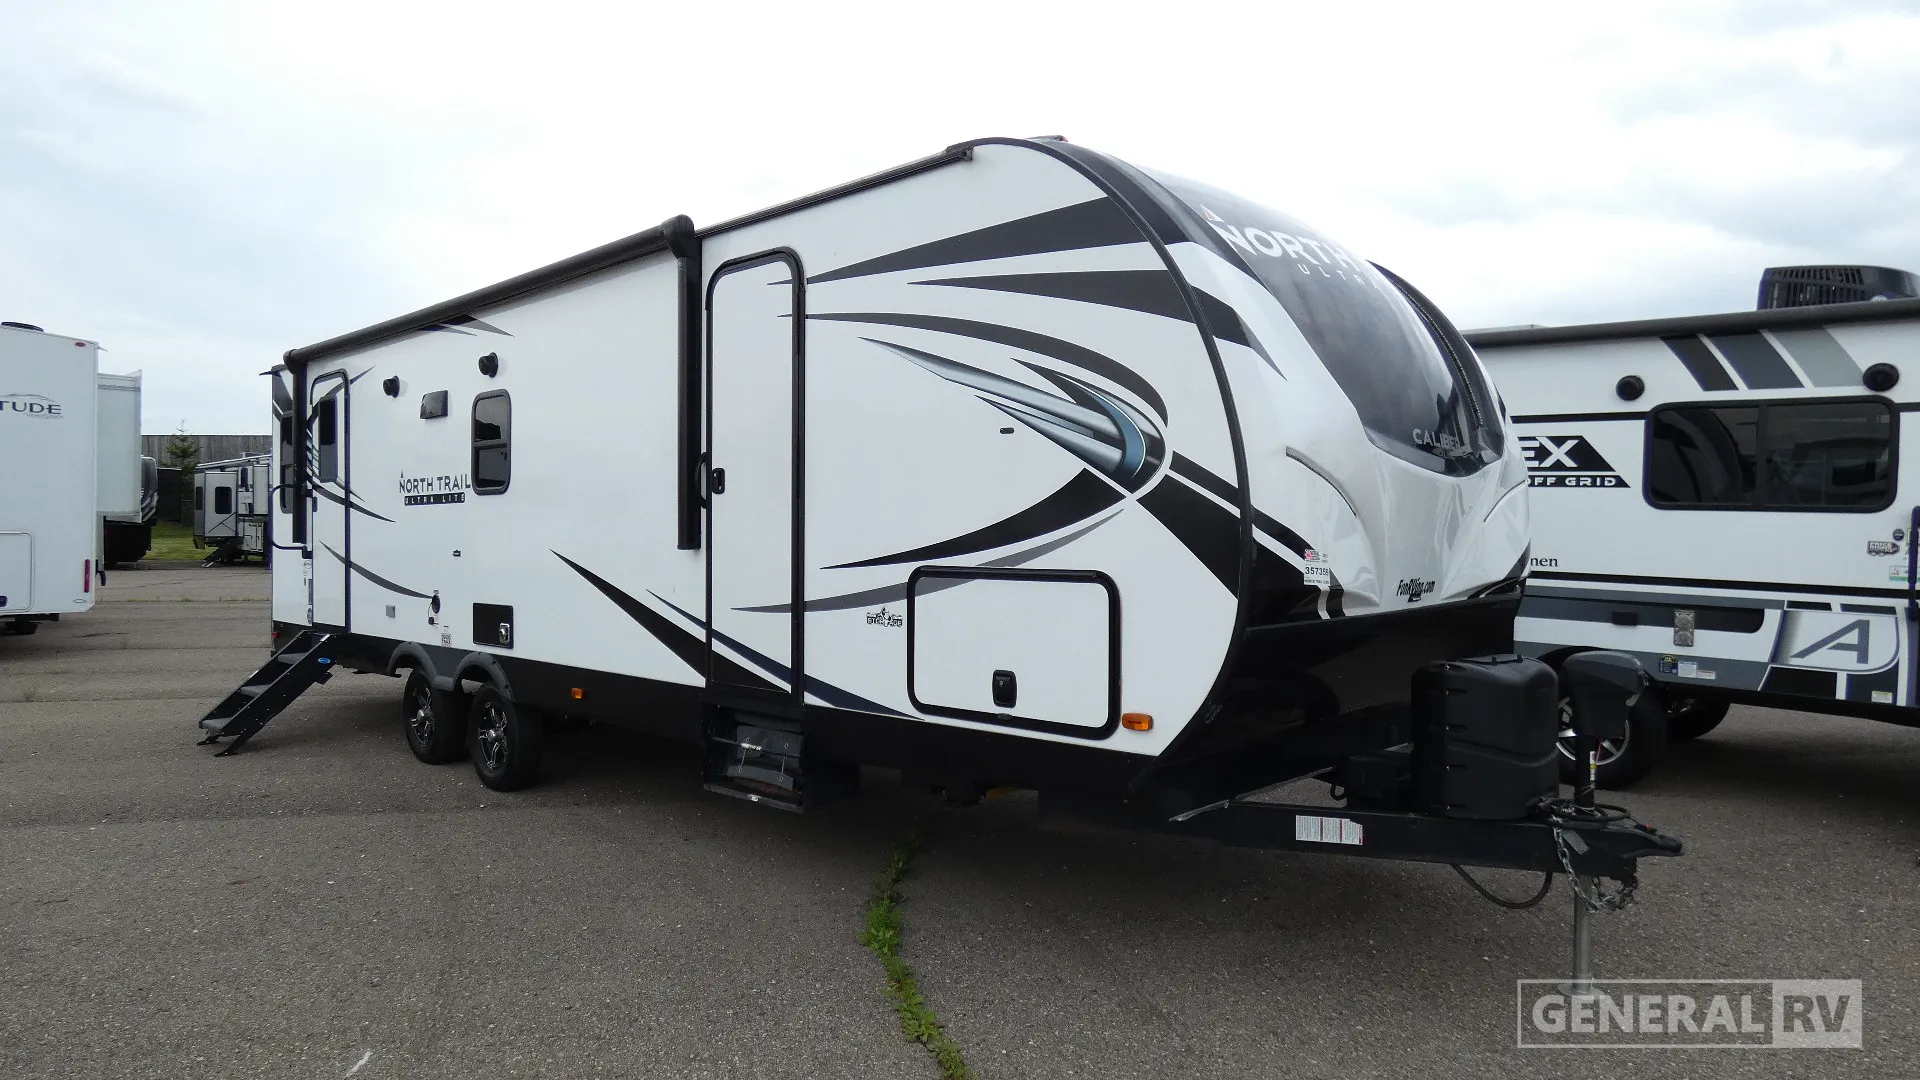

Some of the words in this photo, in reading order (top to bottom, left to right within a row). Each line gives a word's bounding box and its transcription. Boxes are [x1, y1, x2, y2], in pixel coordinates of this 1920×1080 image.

[1206, 220, 1360, 272] NORTH
[399, 477, 434, 494] NORTH
[436, 473, 471, 492] TRAIL
[1564, 477, 1617, 487] GRID
[442, 494, 465, 502] LITE
